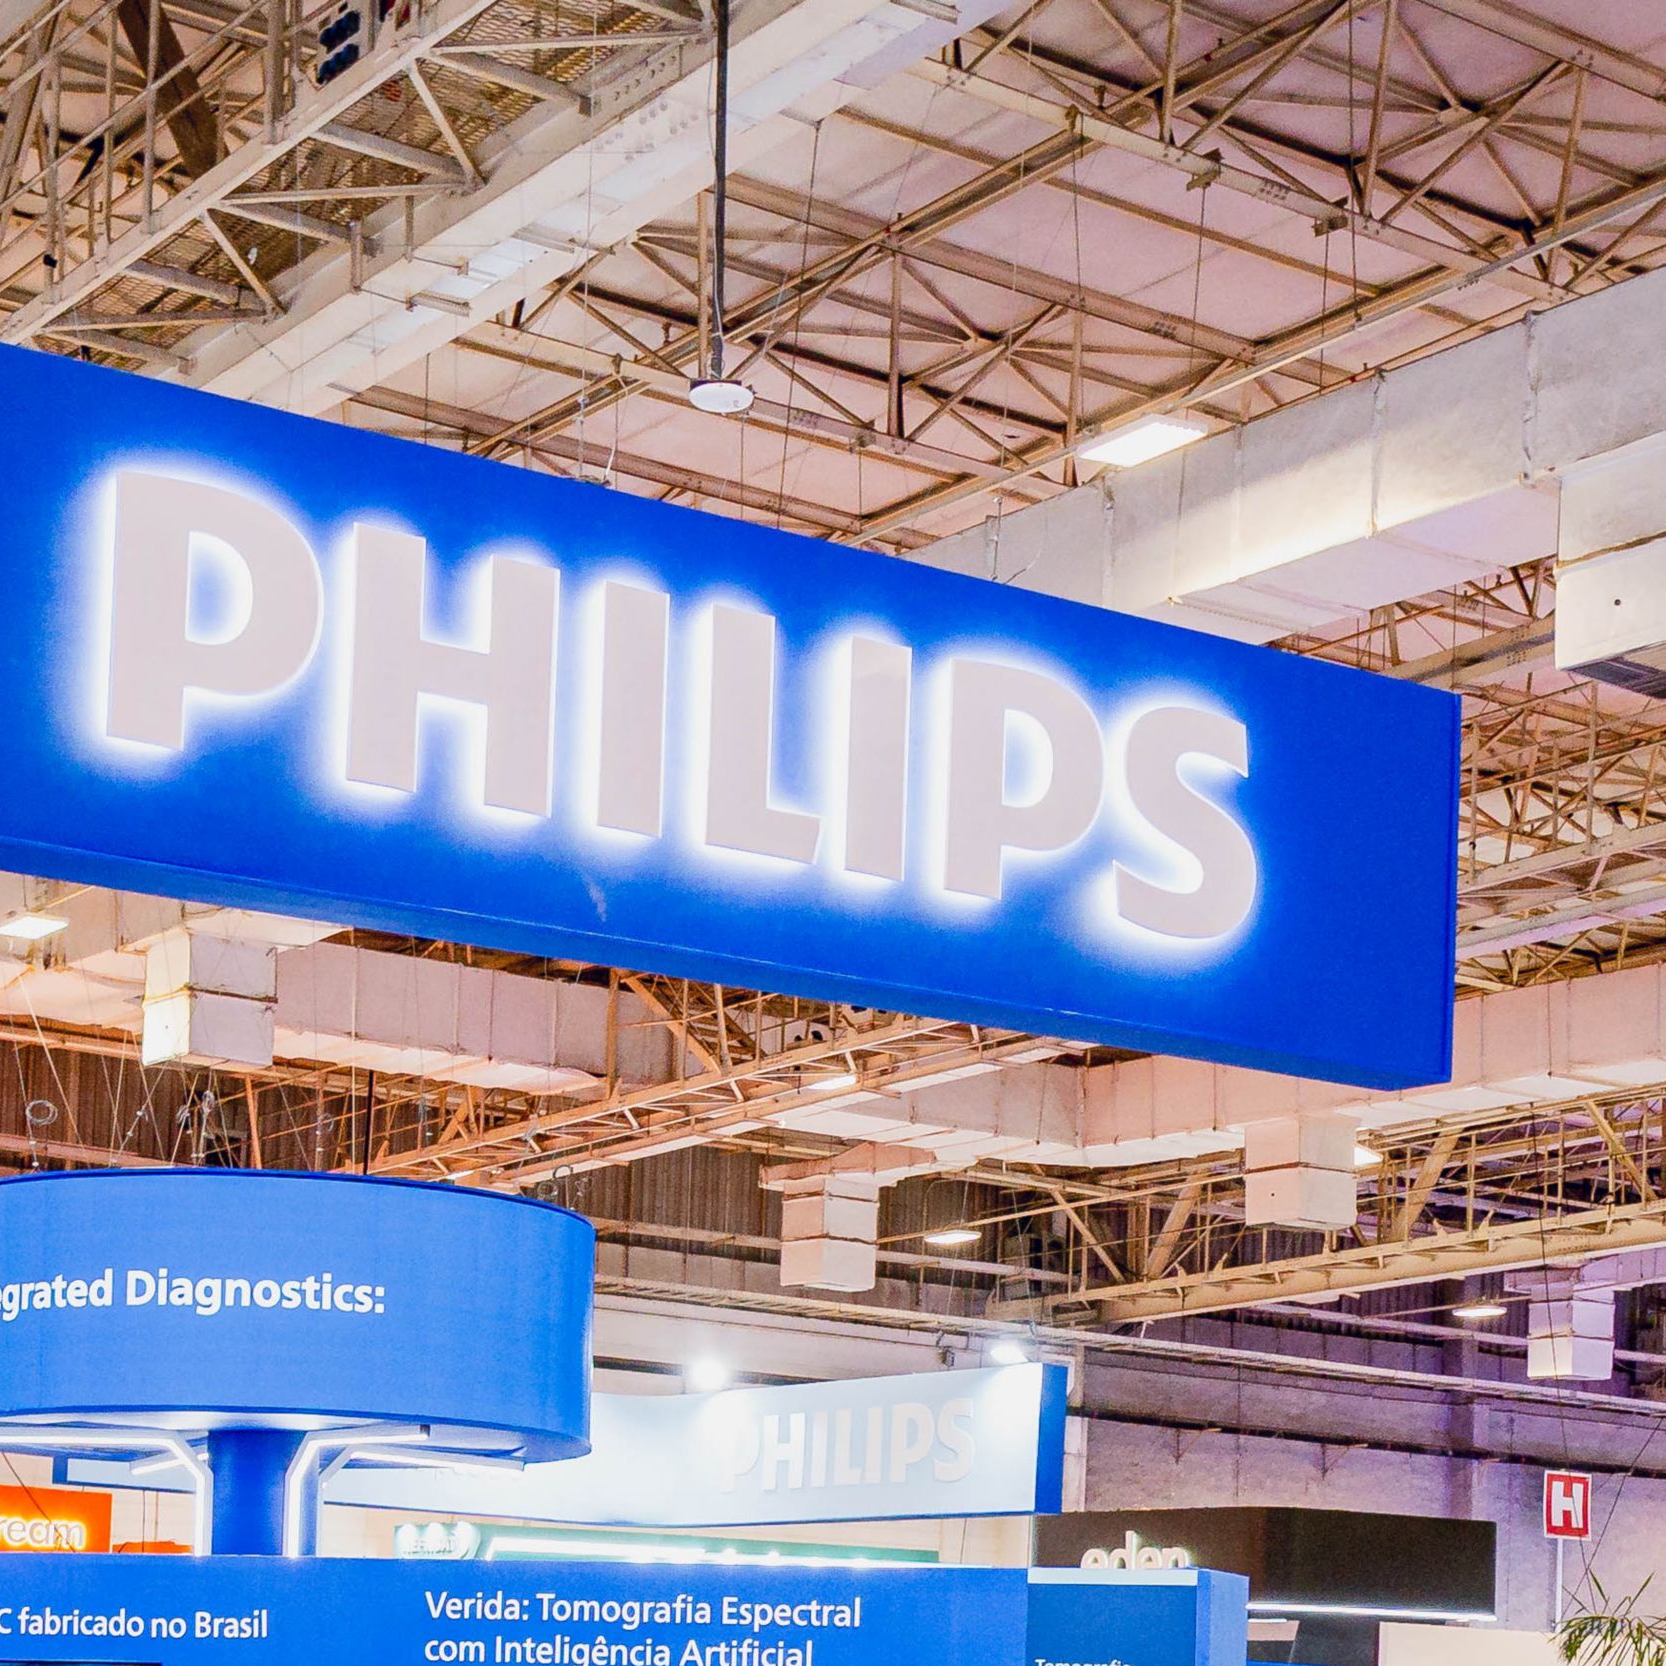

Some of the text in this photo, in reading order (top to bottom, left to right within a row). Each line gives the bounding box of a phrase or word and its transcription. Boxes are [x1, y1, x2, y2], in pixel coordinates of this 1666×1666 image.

[105, 468, 1258, 940] PHILIPS
[126, 1266, 386, 1317] Diagnostics:
[733, 1400, 975, 1492] PHILIPS
[1550, 1481, 1585, 1528] H
[1081, 1531, 1190, 1570] eden
[19, 1608, 143, 1639] fabricado
[150, 1618, 186, 1638] no
[195, 1611, 268, 1639] Brasil
[425, 1592, 861, 1634] Verida: Tomografia Espectral
[425, 1640, 485, 1662] com
